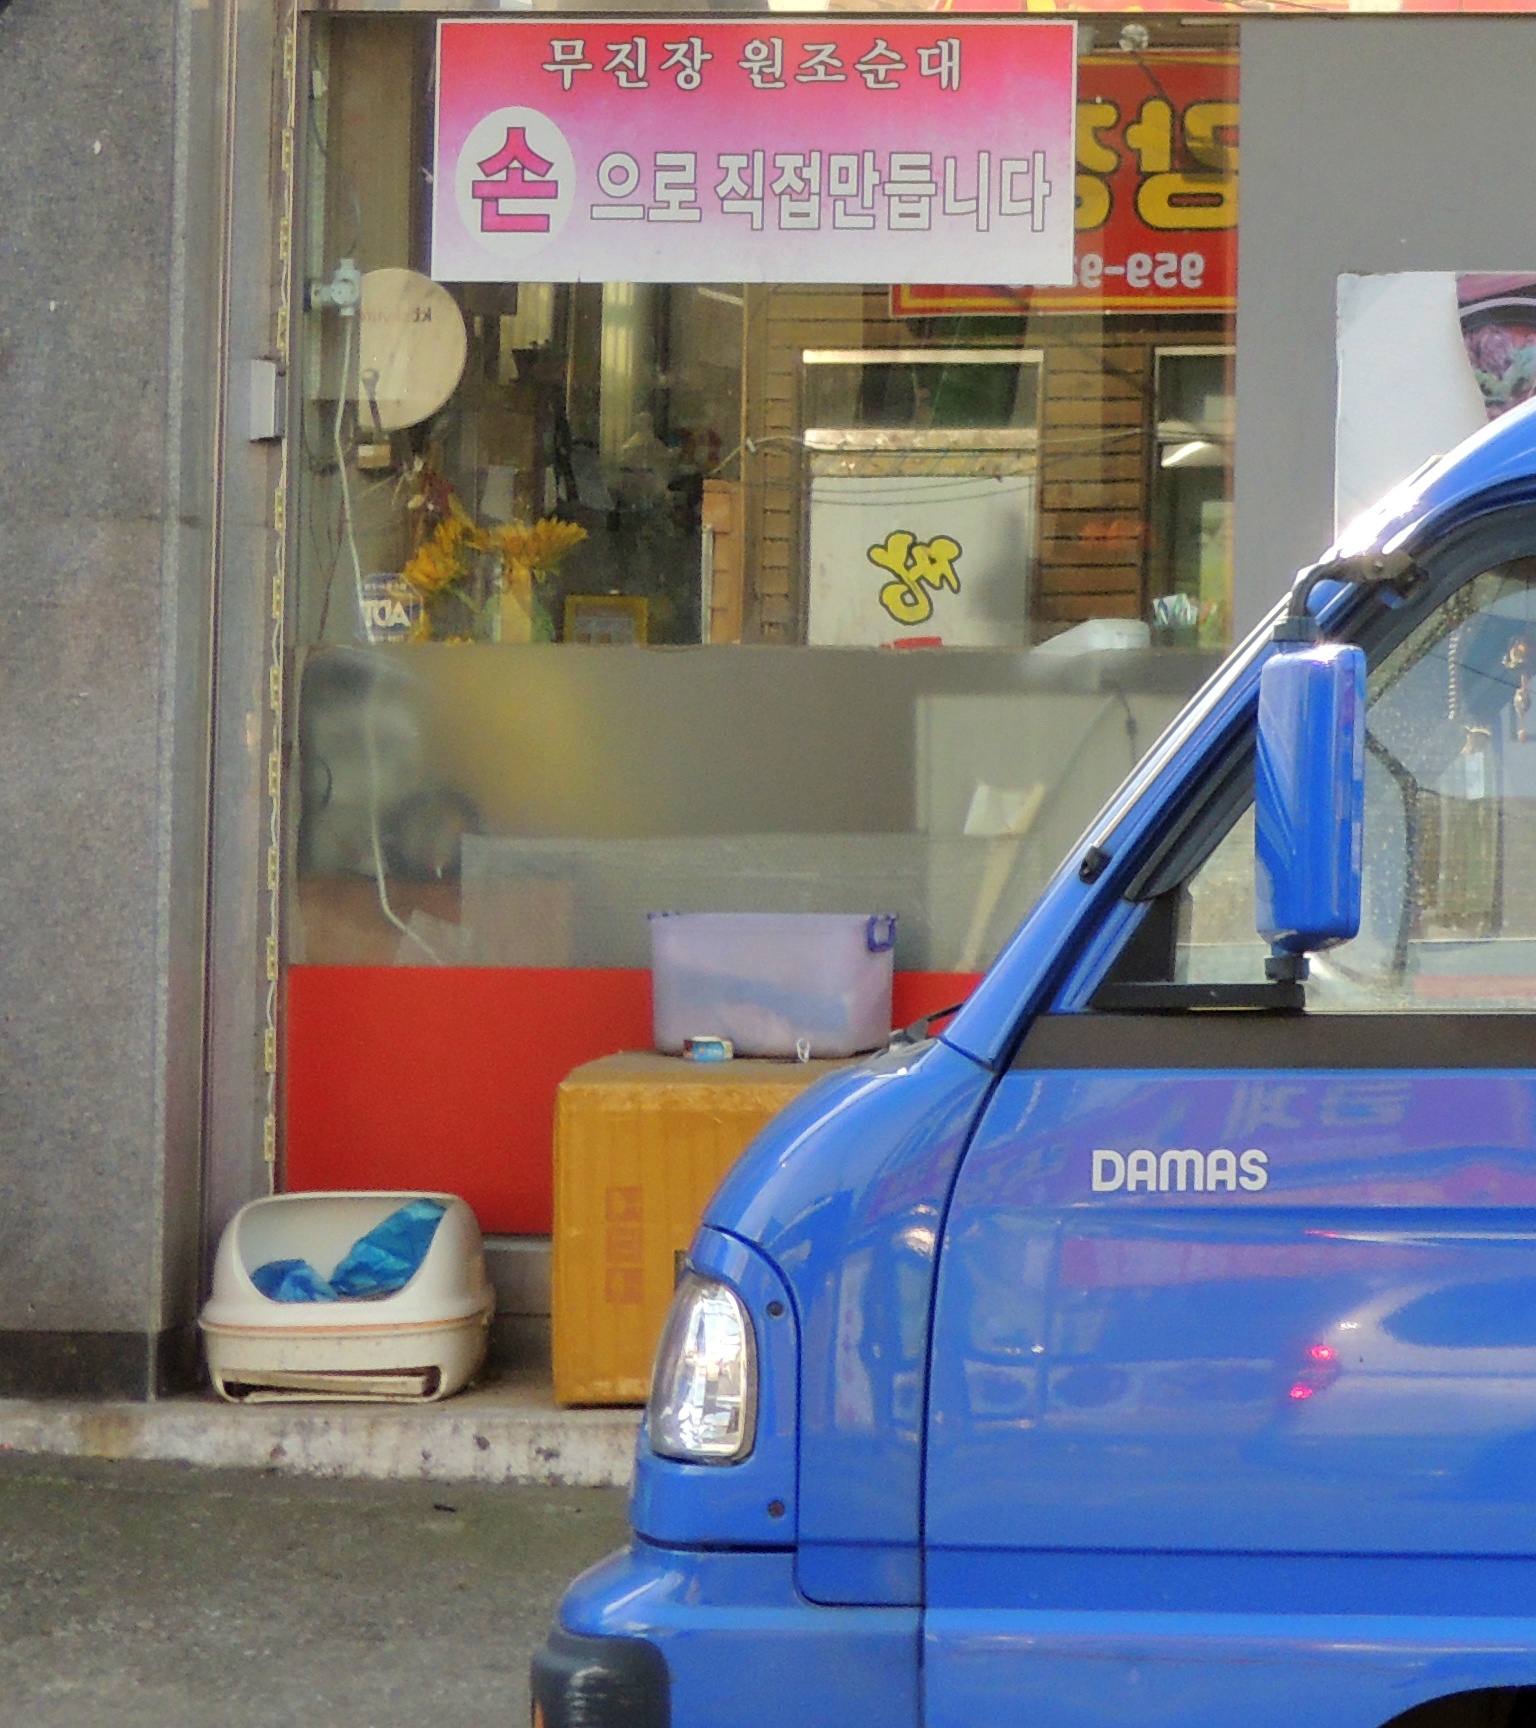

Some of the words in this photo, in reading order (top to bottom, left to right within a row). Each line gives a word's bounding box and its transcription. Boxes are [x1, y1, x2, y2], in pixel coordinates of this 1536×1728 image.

[541, 36, 713, 91] 무진장
[736, 37, 963, 92] 원조순대
[1090, 1148, 1269, 1192] DAMAS
